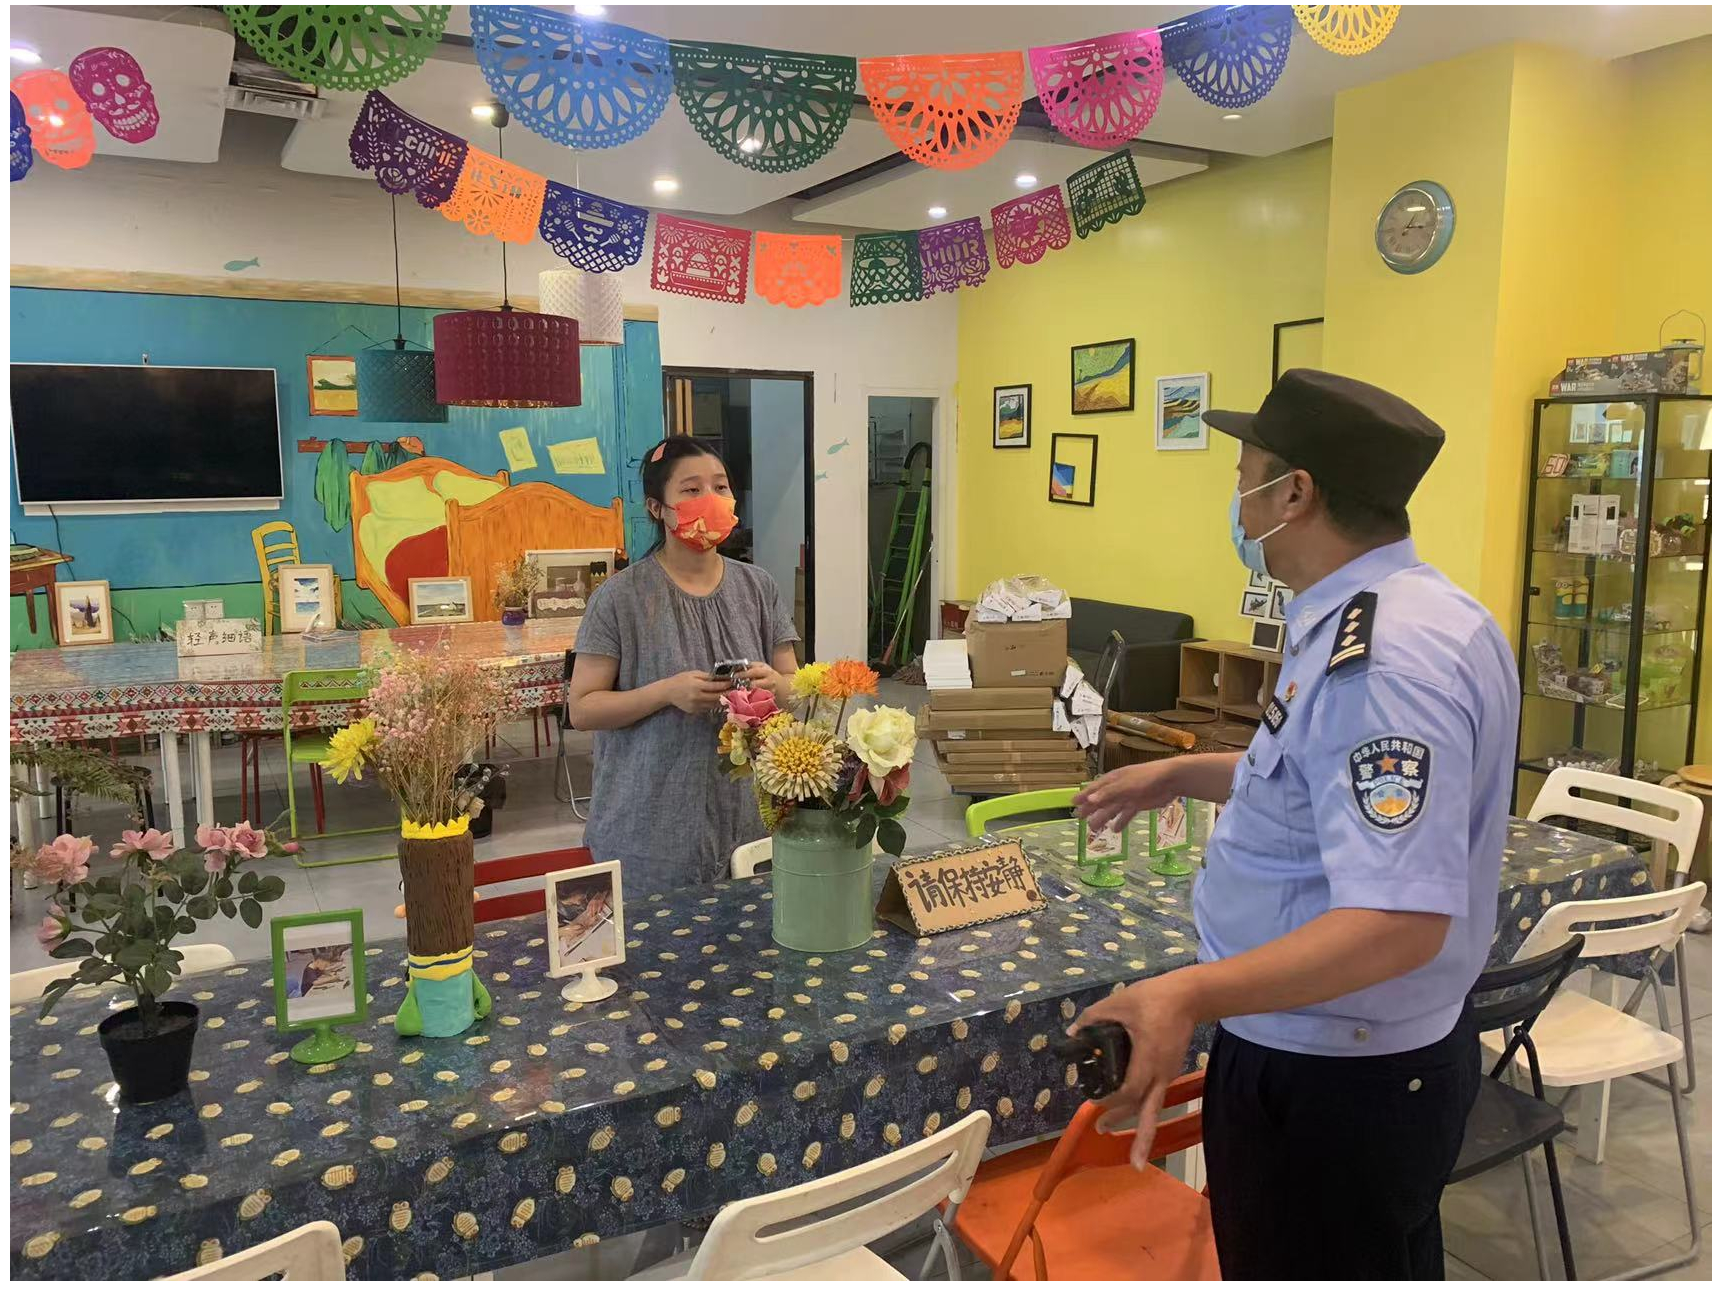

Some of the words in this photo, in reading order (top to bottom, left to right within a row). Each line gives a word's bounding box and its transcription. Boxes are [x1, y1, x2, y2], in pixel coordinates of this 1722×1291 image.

[1560, 383, 1577, 392] WAR
[186, 630, 252, 647] 轻声细语
[1352, 739, 1425, 764] 中华人民共和国
[1358, 763, 1374, 781] 警
[1401, 758, 1420, 777] 察
[905, 855, 1025, 914] 请保持安静
